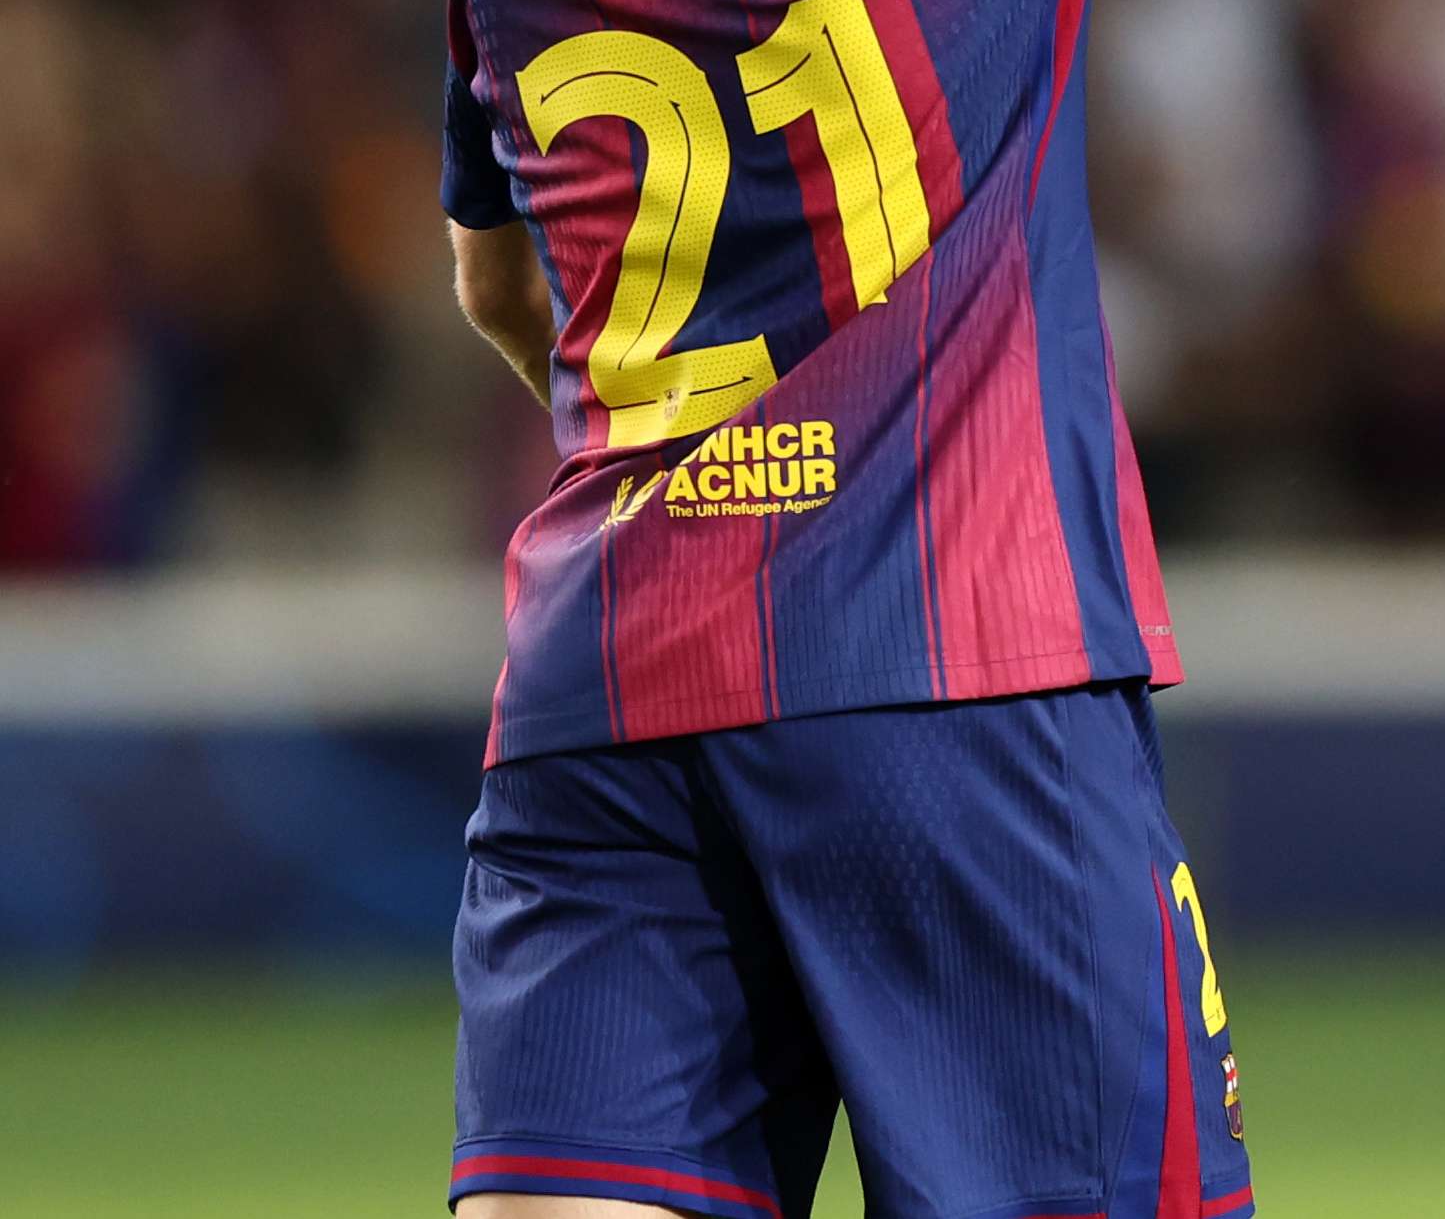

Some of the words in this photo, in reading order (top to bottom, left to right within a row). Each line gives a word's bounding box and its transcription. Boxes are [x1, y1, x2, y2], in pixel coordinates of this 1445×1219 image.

[680, 420, 836, 465] NHCR
[664, 458, 836, 501] ACNUR
[666, 505, 694, 518] The
[696, 504, 719, 517] UN
[721, 502, 781, 517] Refugee
